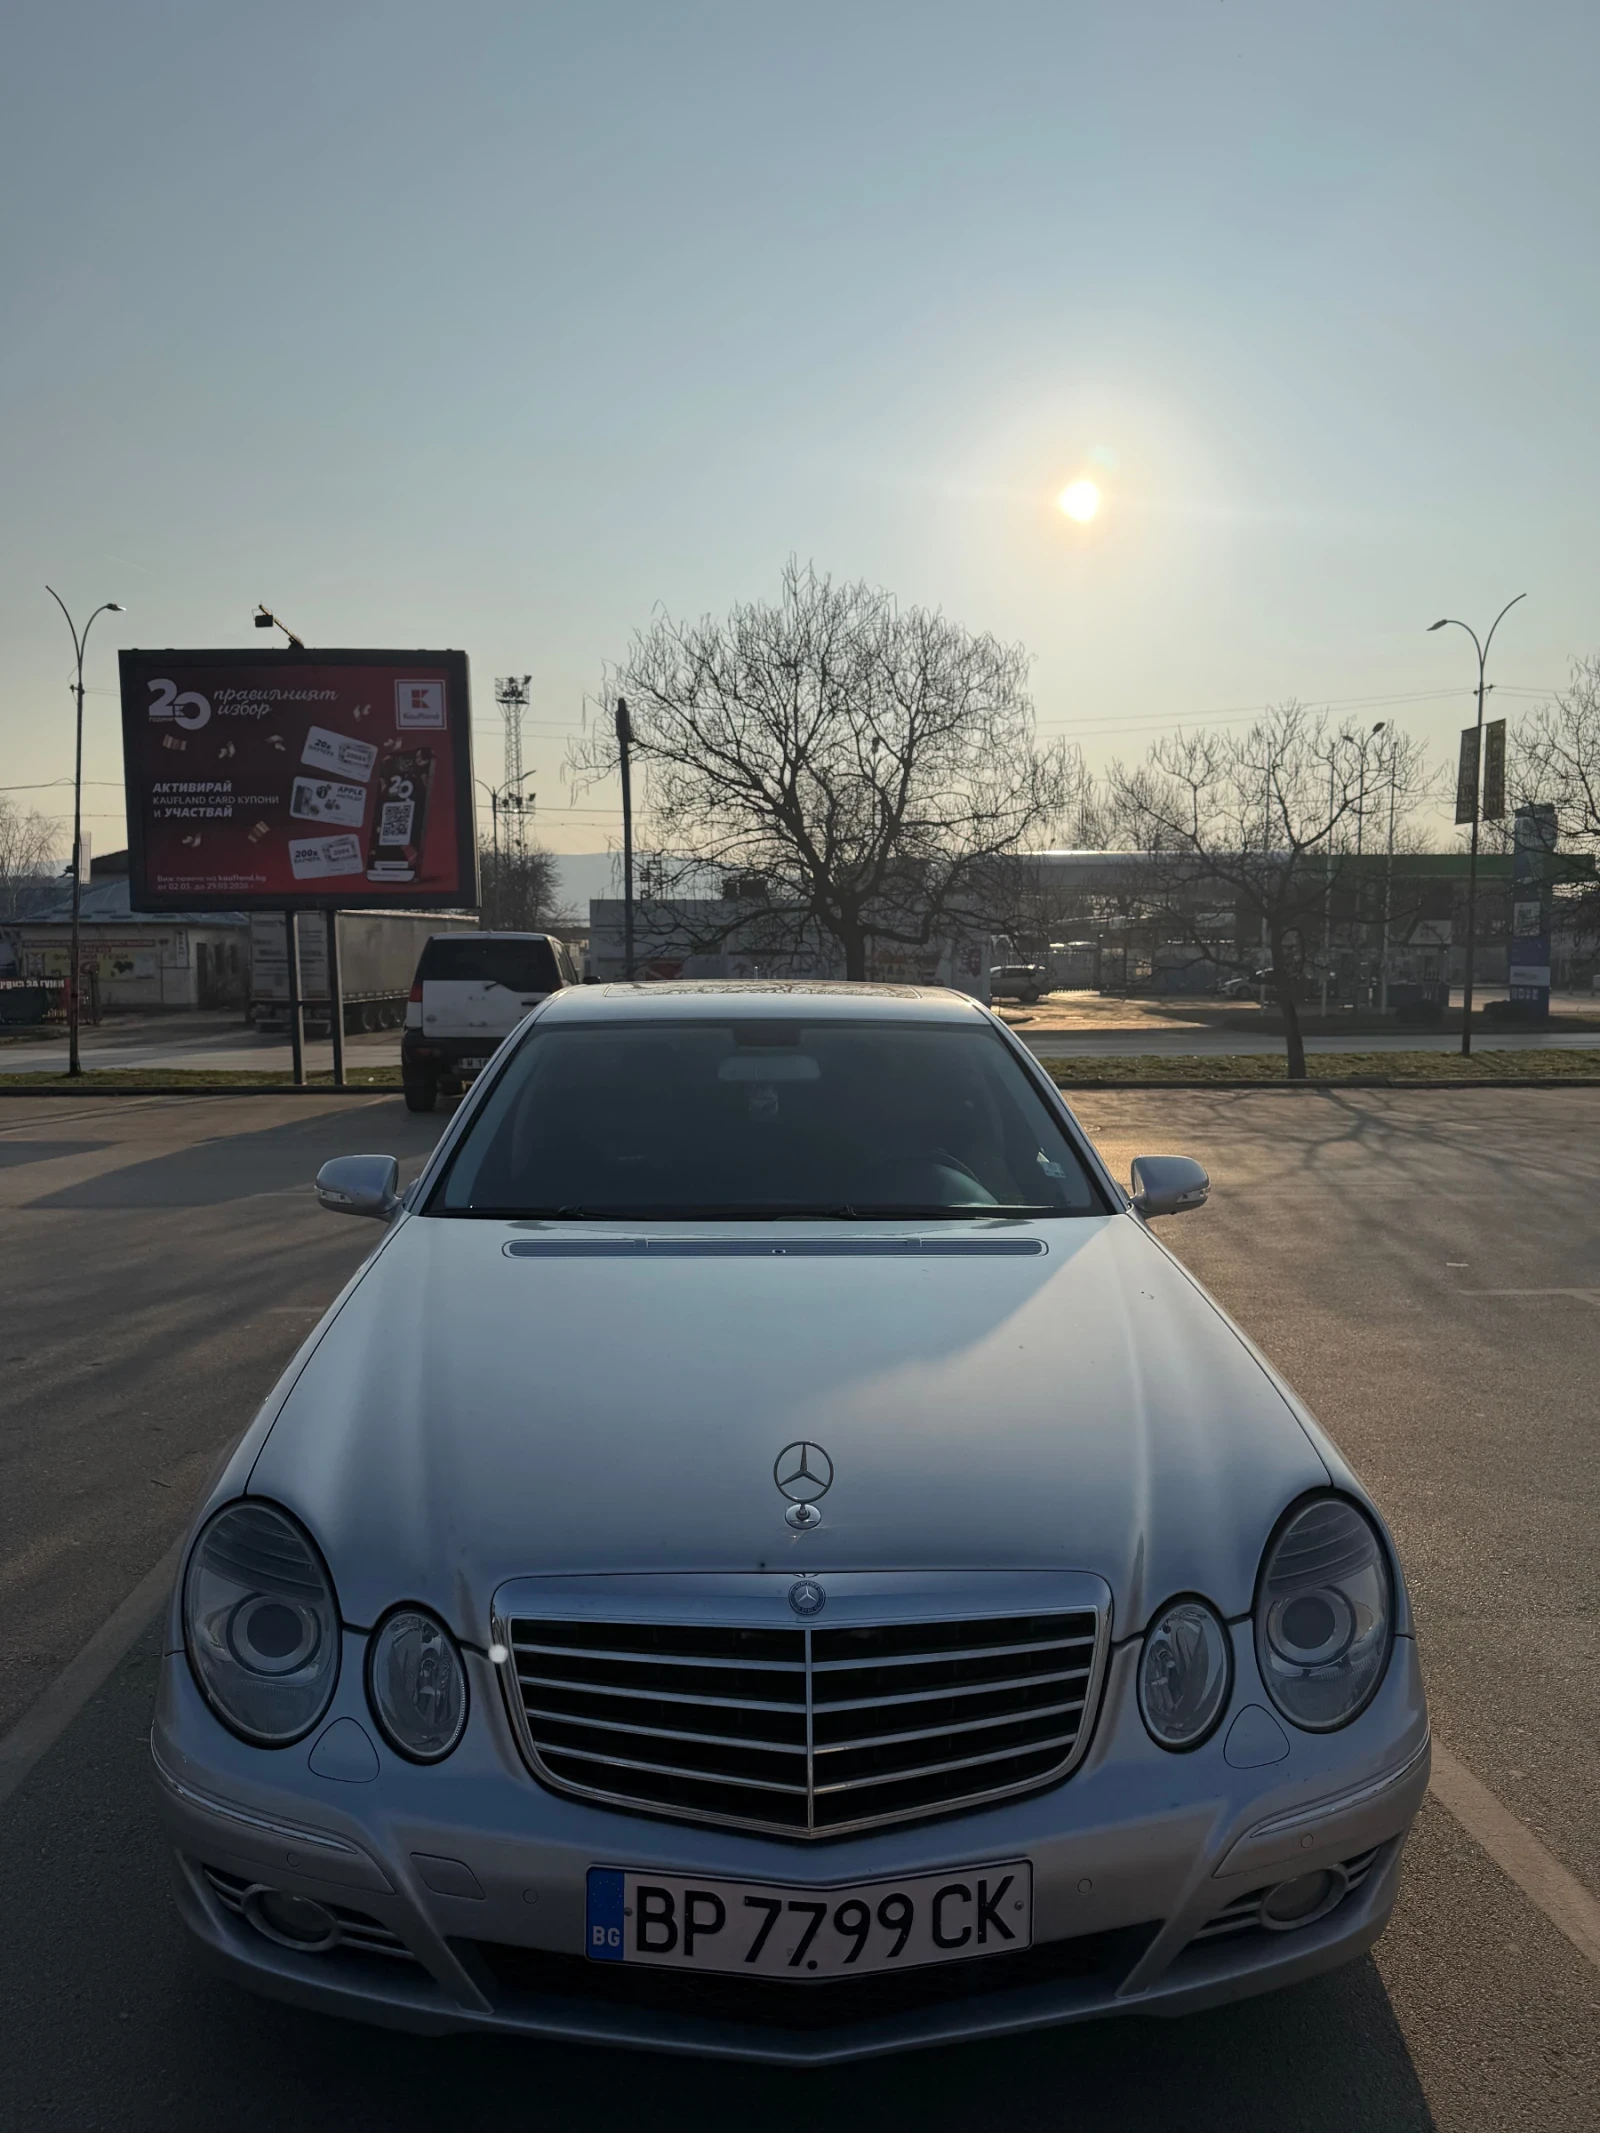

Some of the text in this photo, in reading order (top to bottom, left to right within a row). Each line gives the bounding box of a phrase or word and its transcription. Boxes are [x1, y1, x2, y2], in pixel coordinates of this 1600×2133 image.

[213, 688, 339, 705] правилният
[217, 700, 273, 719] избор
[152, 780, 232, 793] АКТИВИРАЙ
[337, 786, 363, 797] APPLE
[388, 775, 414, 799] 20
[153, 795, 280, 805] KAUFLAND CARD КУПОНИ
[164, 805, 233, 818] УЧАСТВАЙ
[26, 980, 38, 988] ЗА
[40, 979, 65, 989] ГУМИ
[636, 1874, 1017, 1967] BP 7799 CK
[592, 1926, 621, 1947] BG
